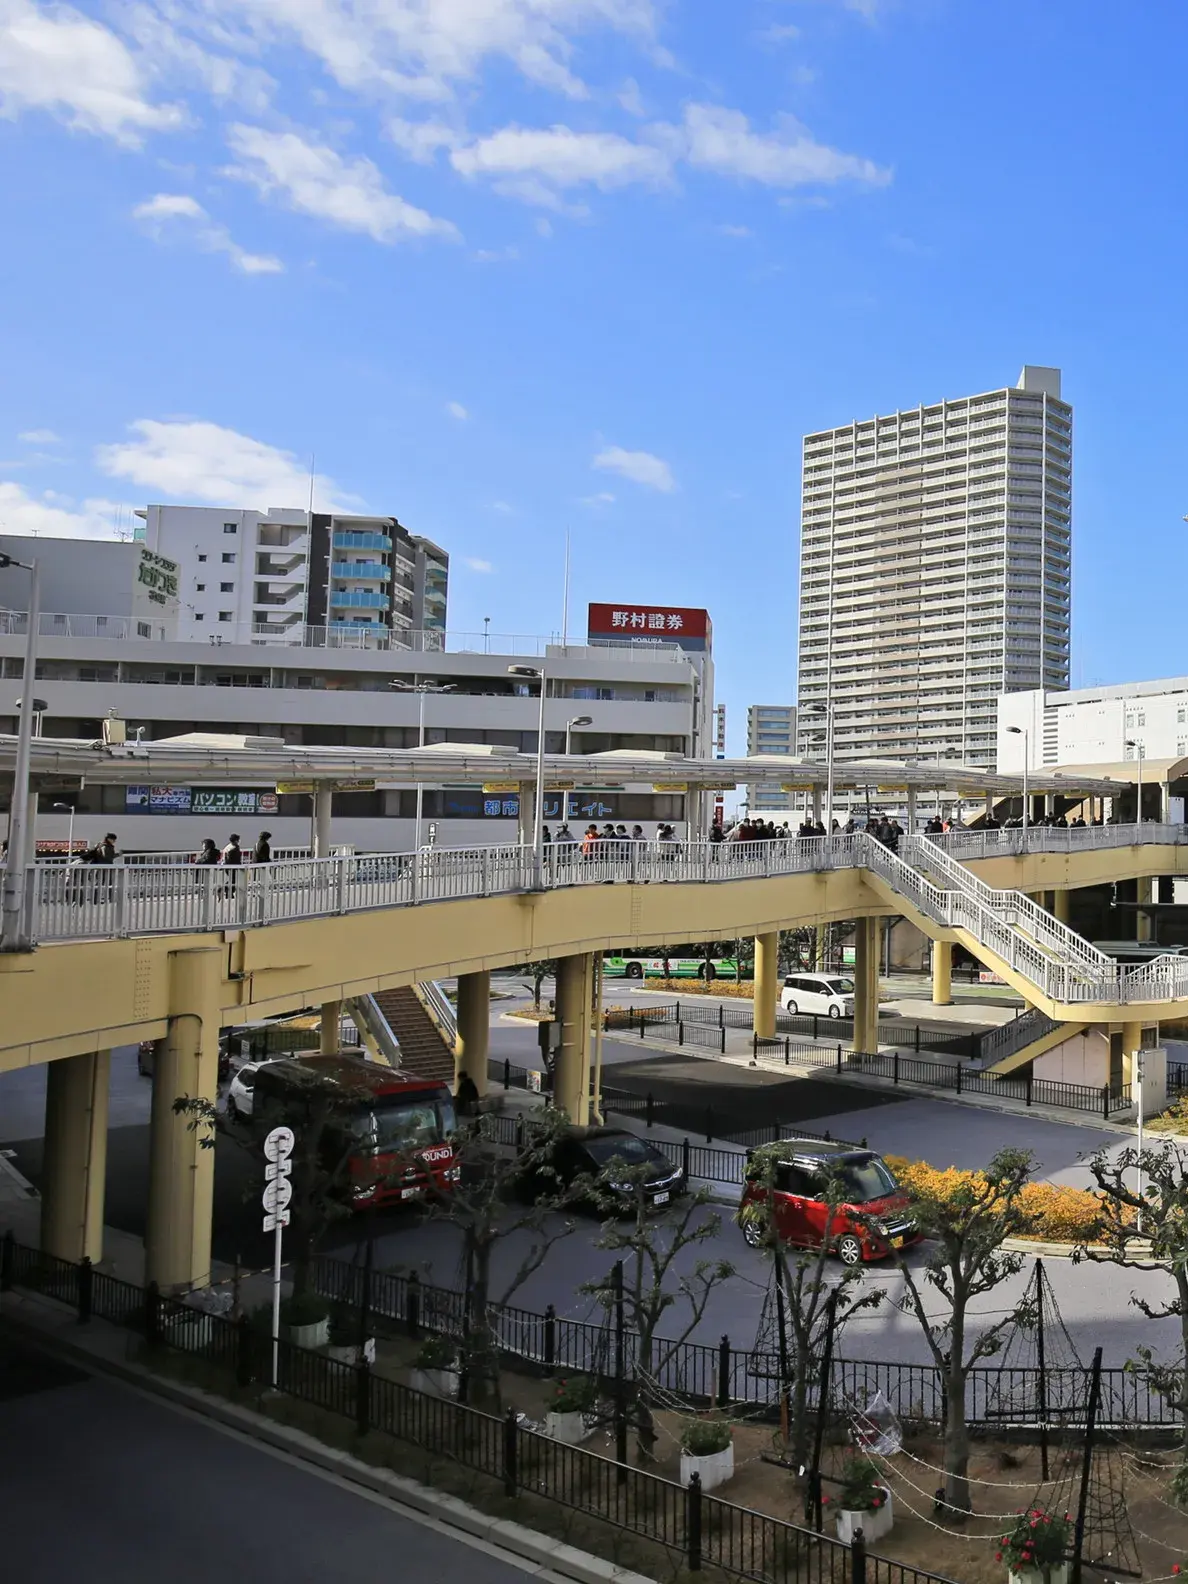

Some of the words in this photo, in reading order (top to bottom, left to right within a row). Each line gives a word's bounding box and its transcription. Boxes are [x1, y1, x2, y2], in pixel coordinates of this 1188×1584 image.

[612, 611, 683, 630] 野村證券
[483, 800, 612, 818] 都市リエイト
